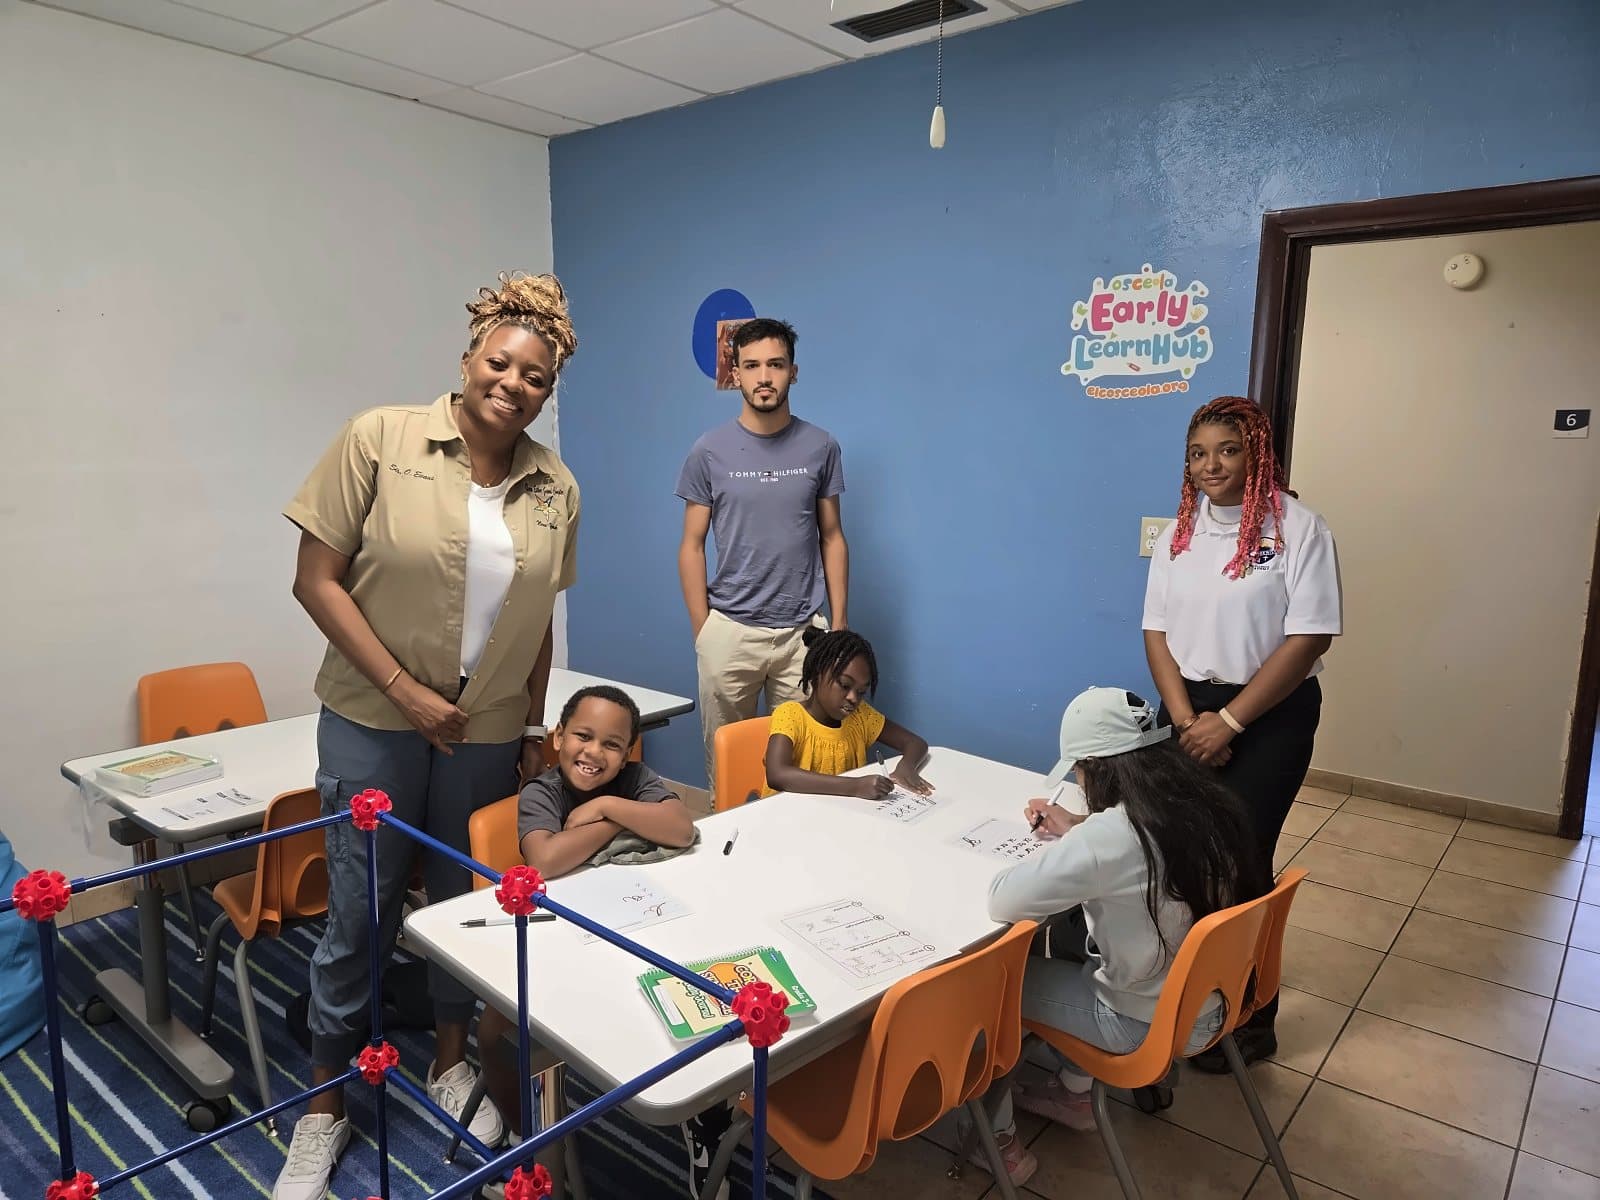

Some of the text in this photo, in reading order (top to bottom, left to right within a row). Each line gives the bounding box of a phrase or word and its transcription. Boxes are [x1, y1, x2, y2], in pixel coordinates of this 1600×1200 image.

[1112, 273, 1174, 291] osceola
[1091, 291, 1189, 332] Early
[1075, 333, 1209, 371] LearnHub
[1086, 381, 1189, 399] elcosceola.org
[1566, 413, 1577, 427] 6
[773, 468, 808, 477] HILFIGER
